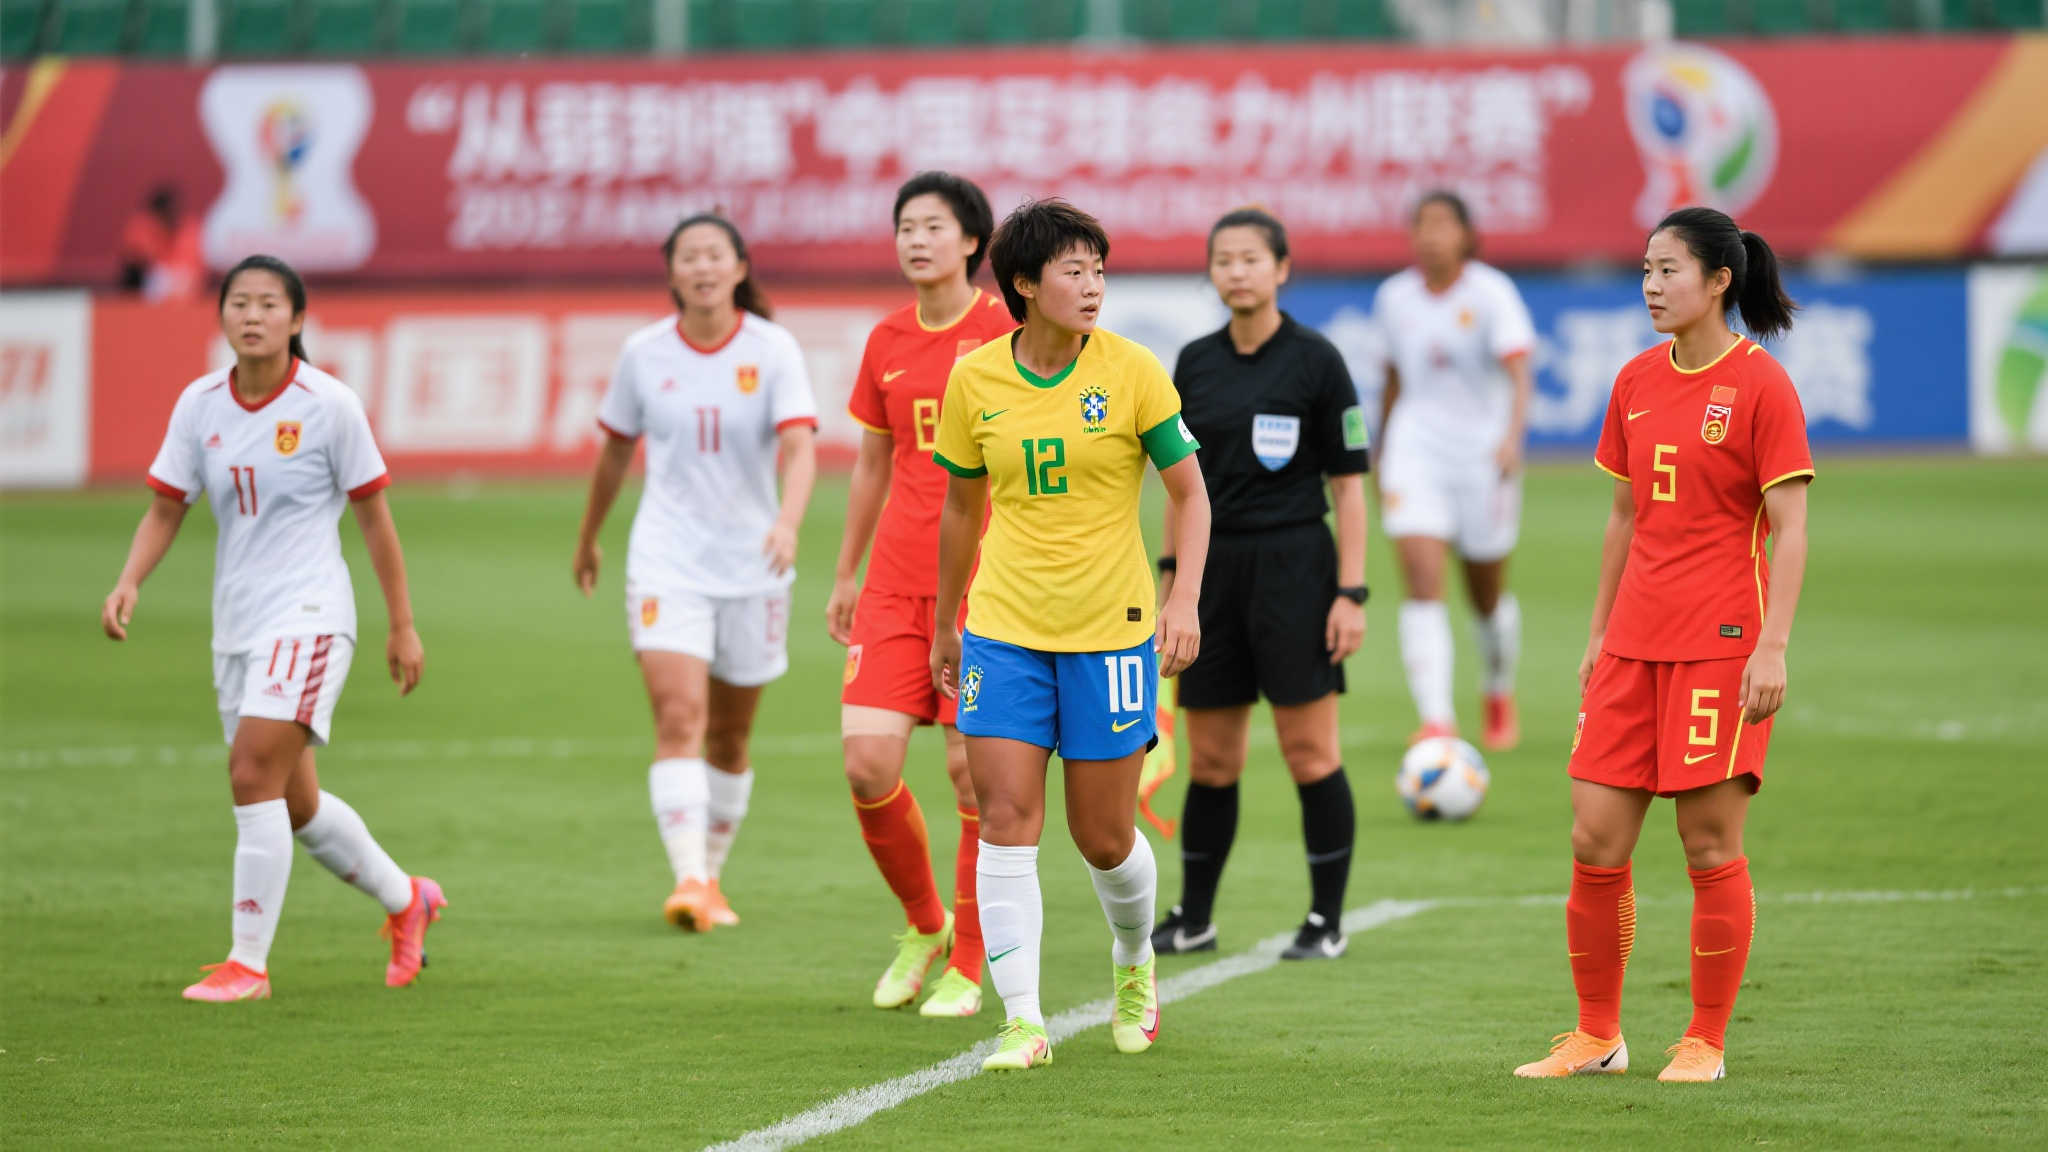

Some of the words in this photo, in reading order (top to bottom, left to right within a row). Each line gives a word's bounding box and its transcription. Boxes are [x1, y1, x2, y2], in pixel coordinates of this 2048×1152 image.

[694, 405, 721, 454] 11
[228, 465, 257, 516] 11
[1021, 437, 1068, 497] 12
[1652, 443, 1679, 502] 5
[266, 636, 301, 681] 11
[1104, 655, 1144, 713] 10
[1688, 688, 1720, 746] 5
